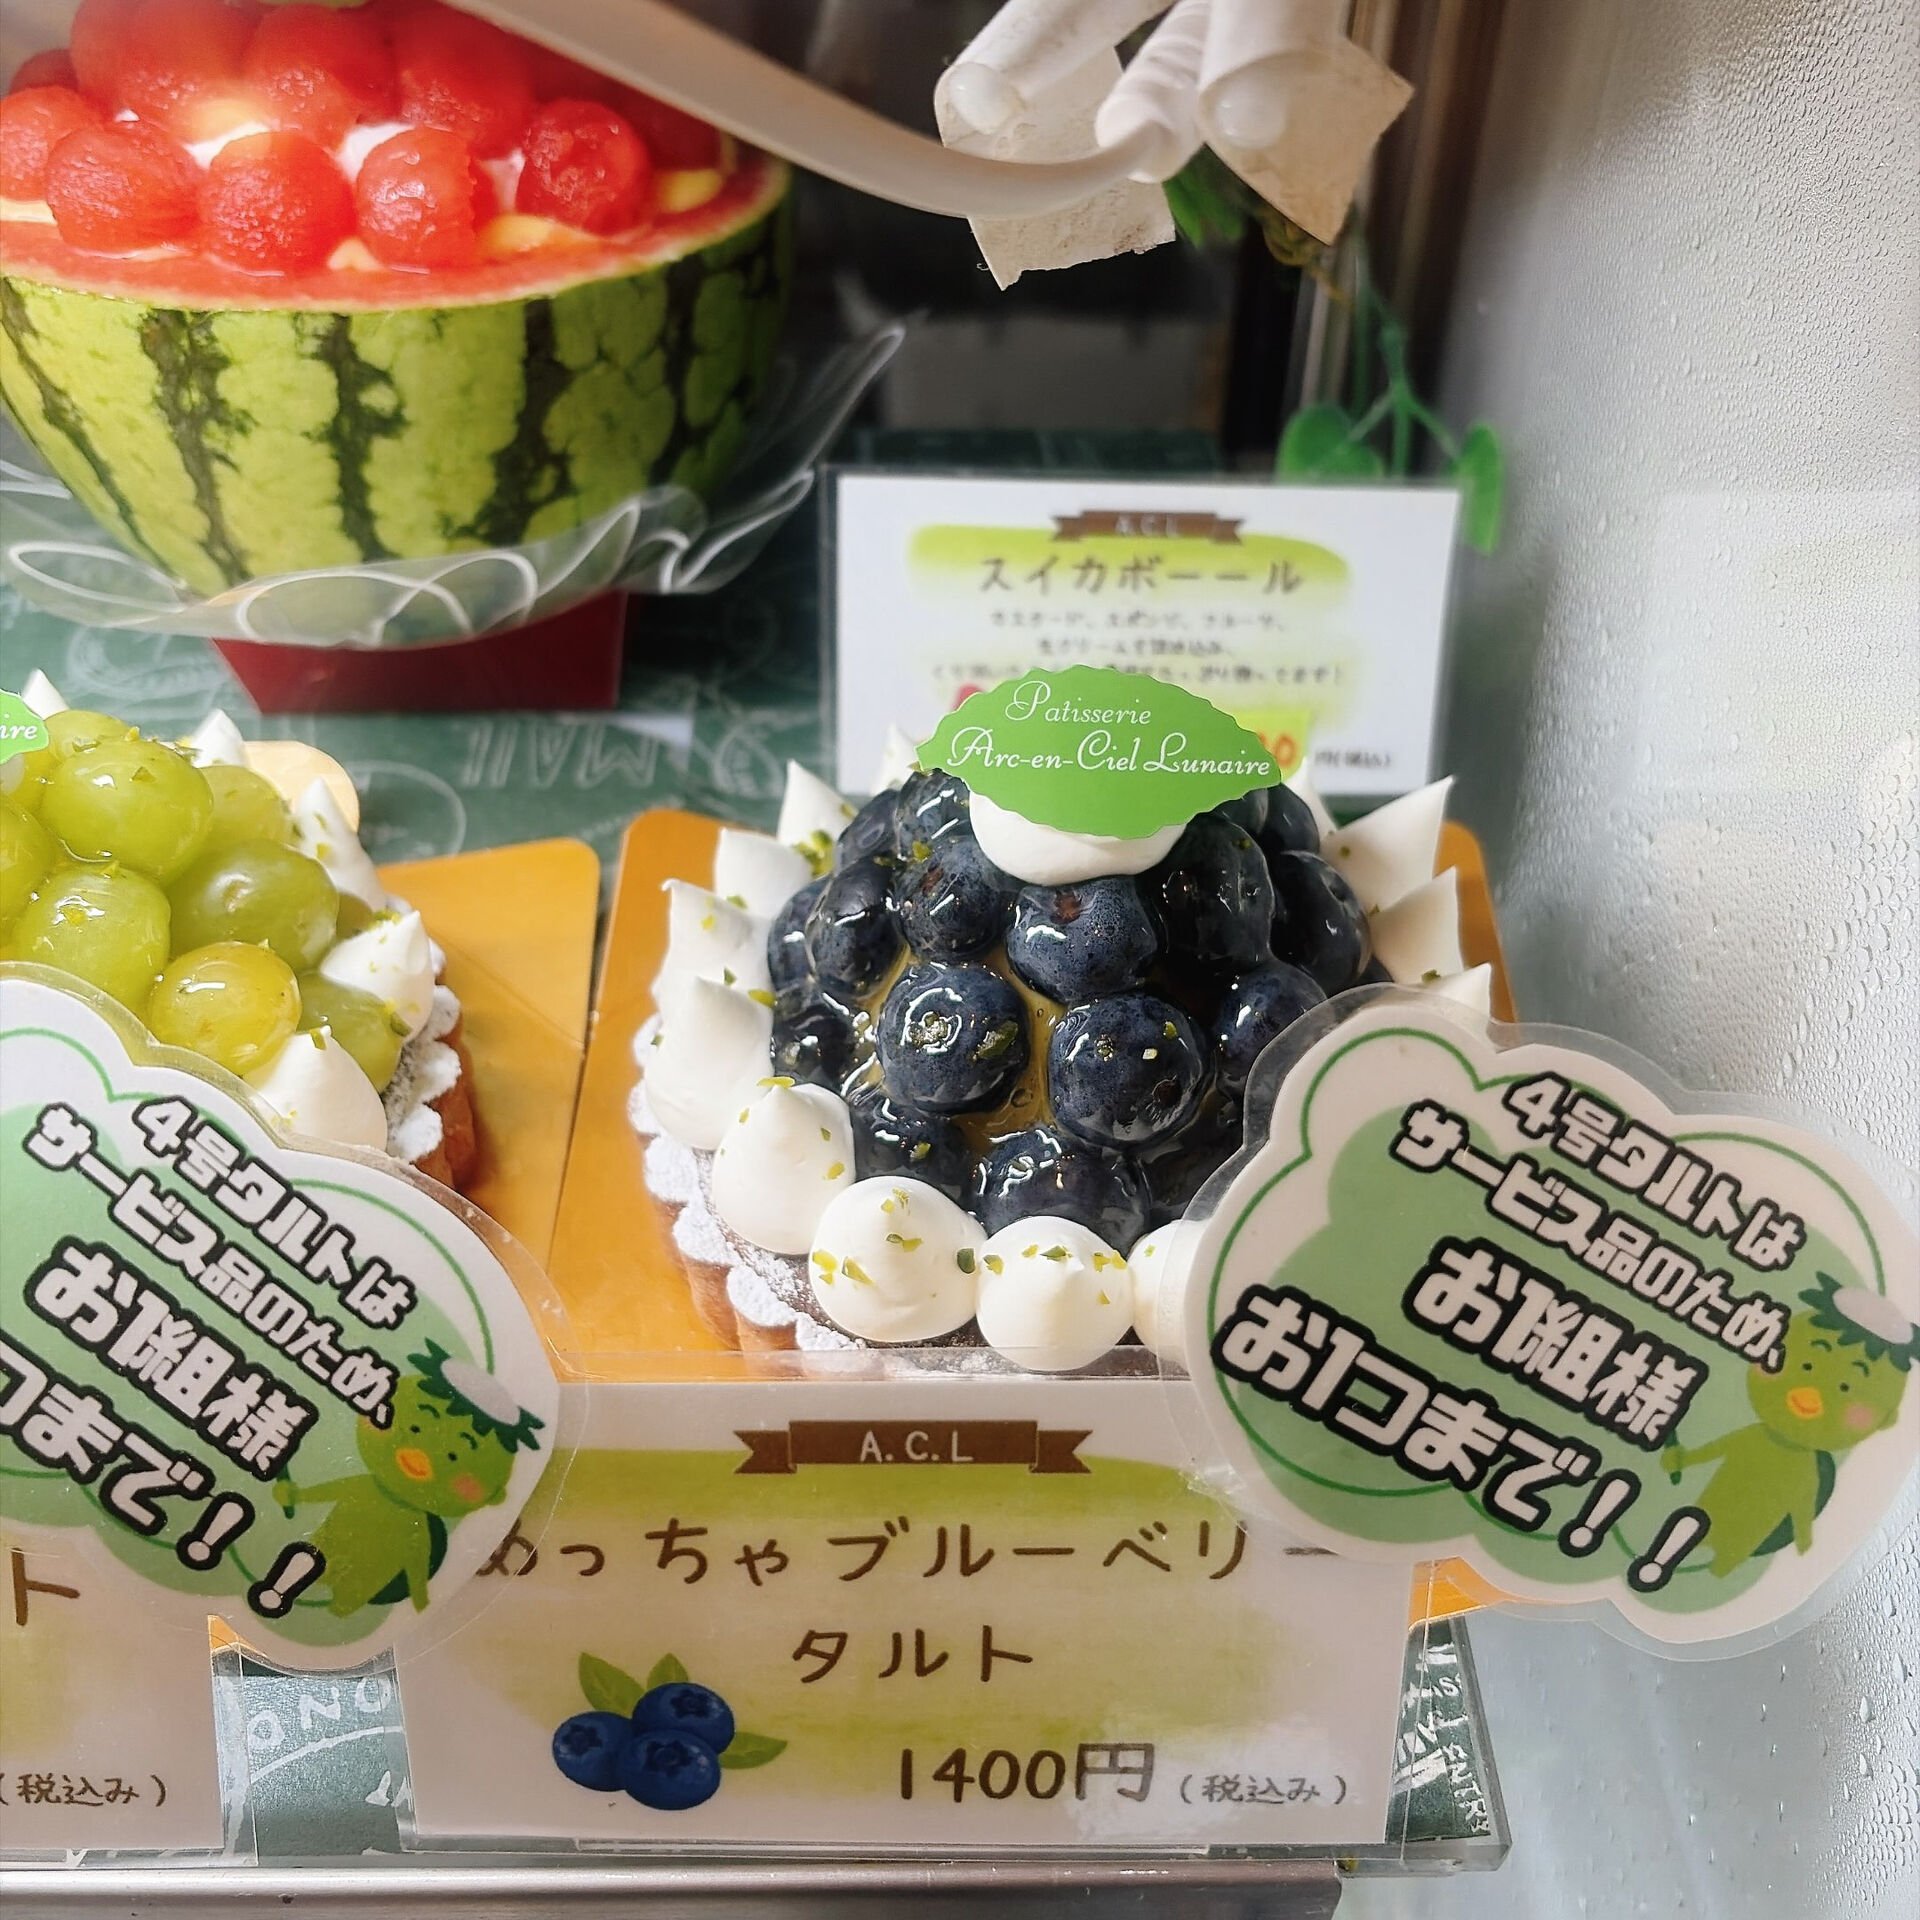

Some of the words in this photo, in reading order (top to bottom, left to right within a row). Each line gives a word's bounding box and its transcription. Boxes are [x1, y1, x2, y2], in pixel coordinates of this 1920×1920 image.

[980, 555, 1303, 594] スイカボーール
[1004, 680, 1152, 725] Patisserie
[945, 725, 1138, 773] Arc-en-Ciel
[1142, 730, 1271, 777] Lunaire
[1502, 1071, 1805, 1272] 4号タルトは
[133, 1097, 416, 1328] 4号タルトは
[1390, 1100, 1790, 1373] サービス品のため、
[23, 1103, 398, 1429] サービス品のため、
[25, 1236, 317, 1480] お1組様
[1403, 1237, 1708, 1451] お1組様
[860, 1430, 974, 1463] A.C.L
[11, 1546, 80, 1626] ト
[792, 1625, 1033, 1684] タルト
[900, 1742, 1155, 1803] 1400円
